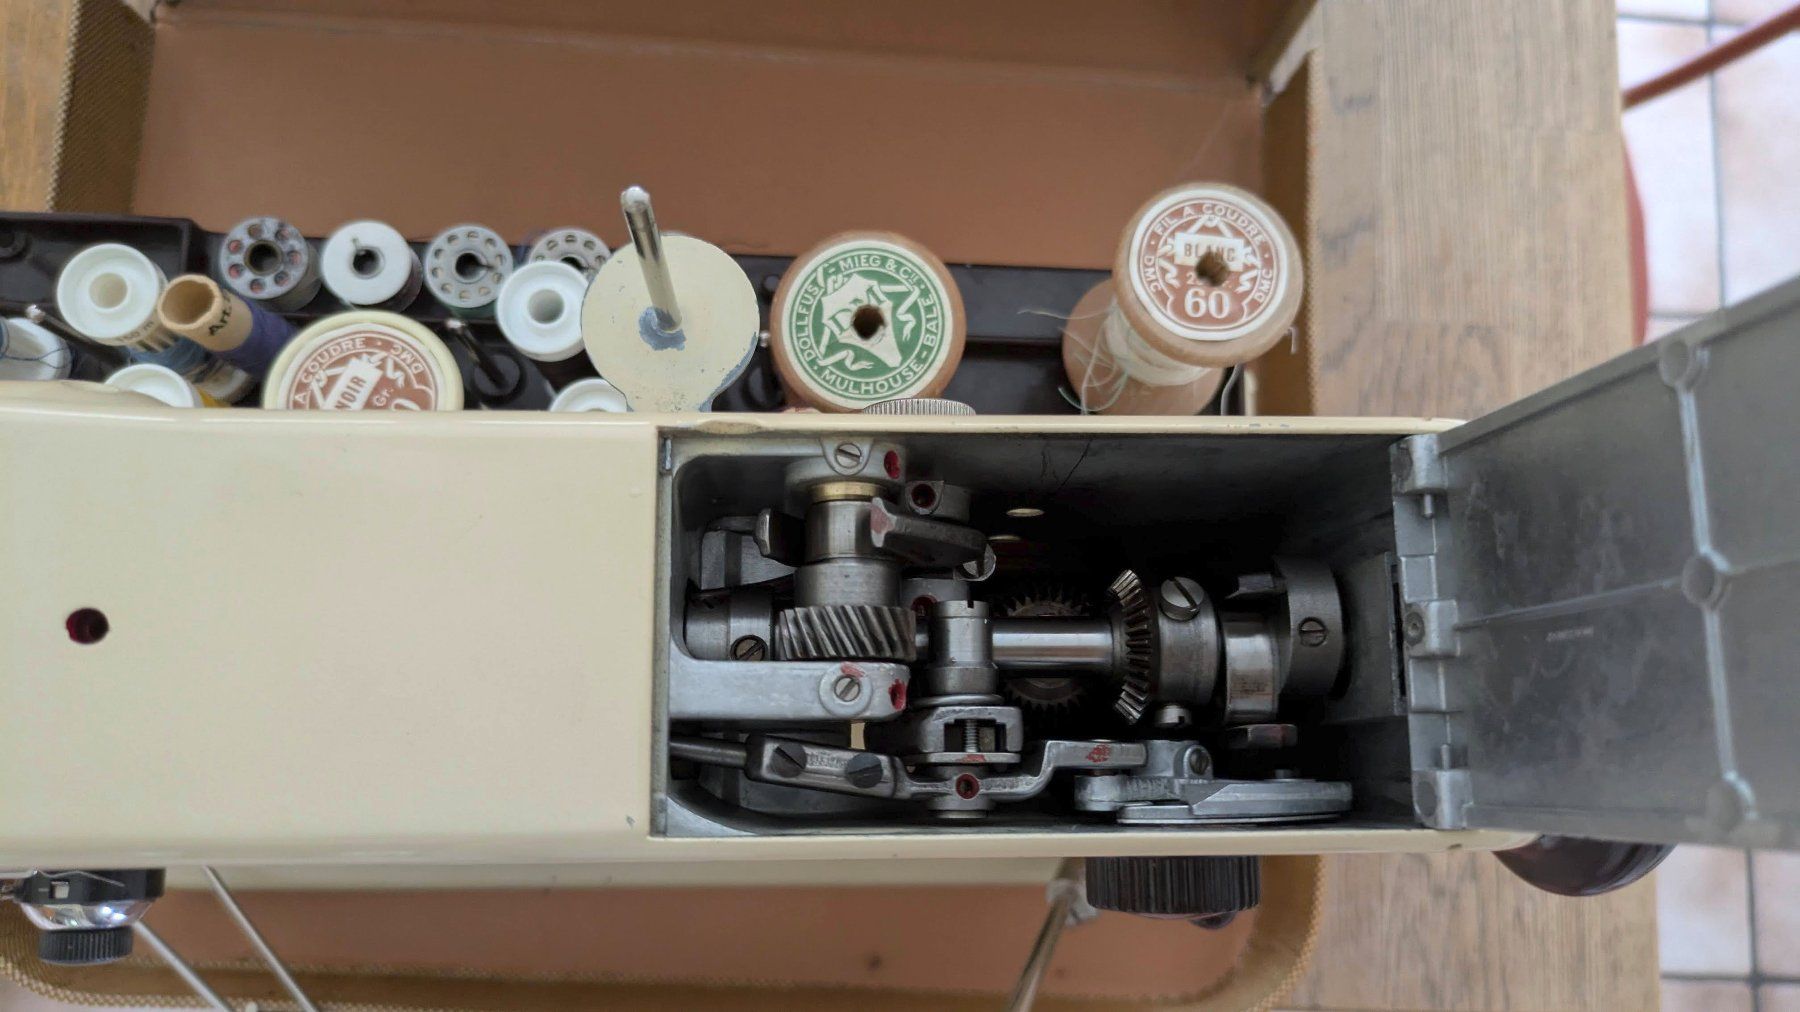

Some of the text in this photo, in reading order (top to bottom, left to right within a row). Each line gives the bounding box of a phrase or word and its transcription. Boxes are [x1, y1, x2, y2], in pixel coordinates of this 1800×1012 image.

[1154, 203, 1264, 245] FIL A COUDRE
[1144, 256, 1163, 294] DMC
[1253, 269, 1273, 303] DMC
[796, 283, 819, 362] DOLLFUS
[839, 255, 881, 272] MIEG
[884, 258, 898, 273] &
[1184, 287, 1231, 319] 60
[301, 336, 367, 384] COUDRE
[390, 343, 426, 375] DMC
[820, 359, 924, 394] MULHOUSE
